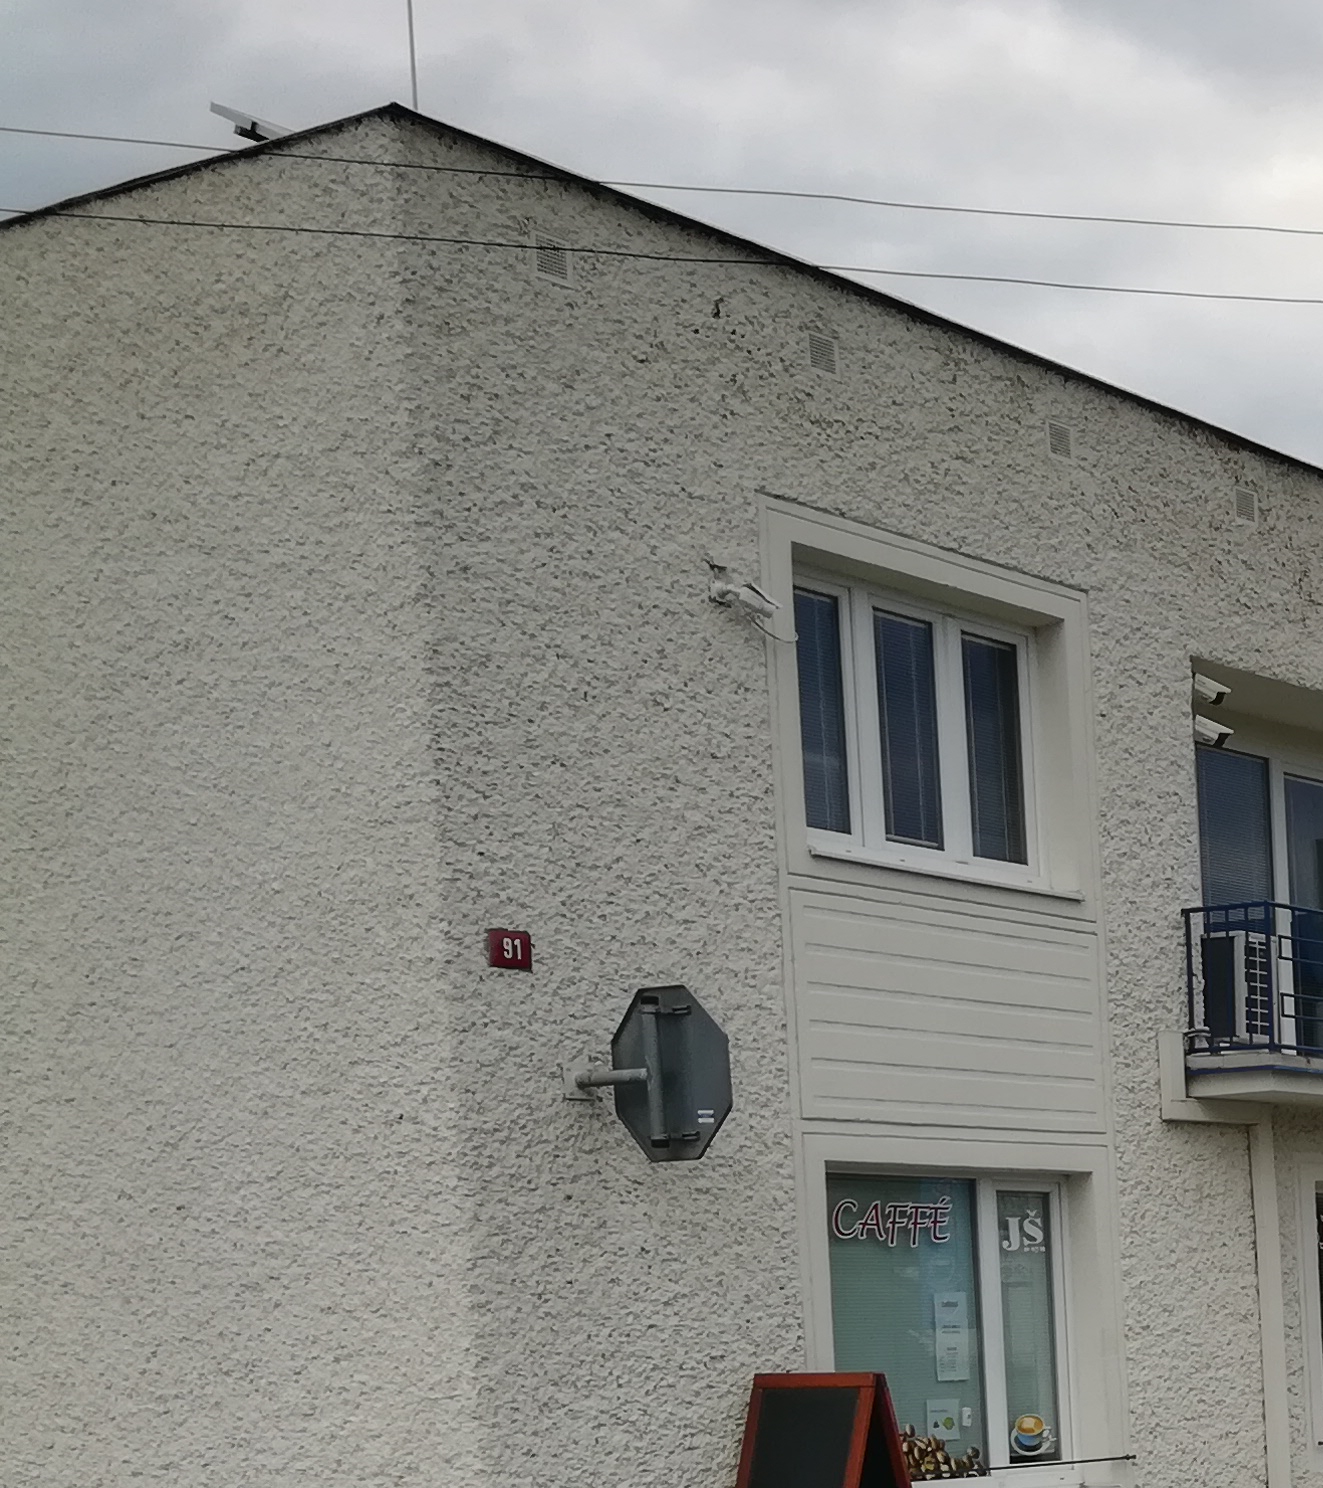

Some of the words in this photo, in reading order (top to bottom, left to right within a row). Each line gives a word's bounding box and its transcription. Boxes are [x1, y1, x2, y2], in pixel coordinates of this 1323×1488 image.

[503, 937, 521, 960] 91
[832, 1195, 953, 1248] CAFFÉ
[1001, 1209, 1044, 1251] JŠ
